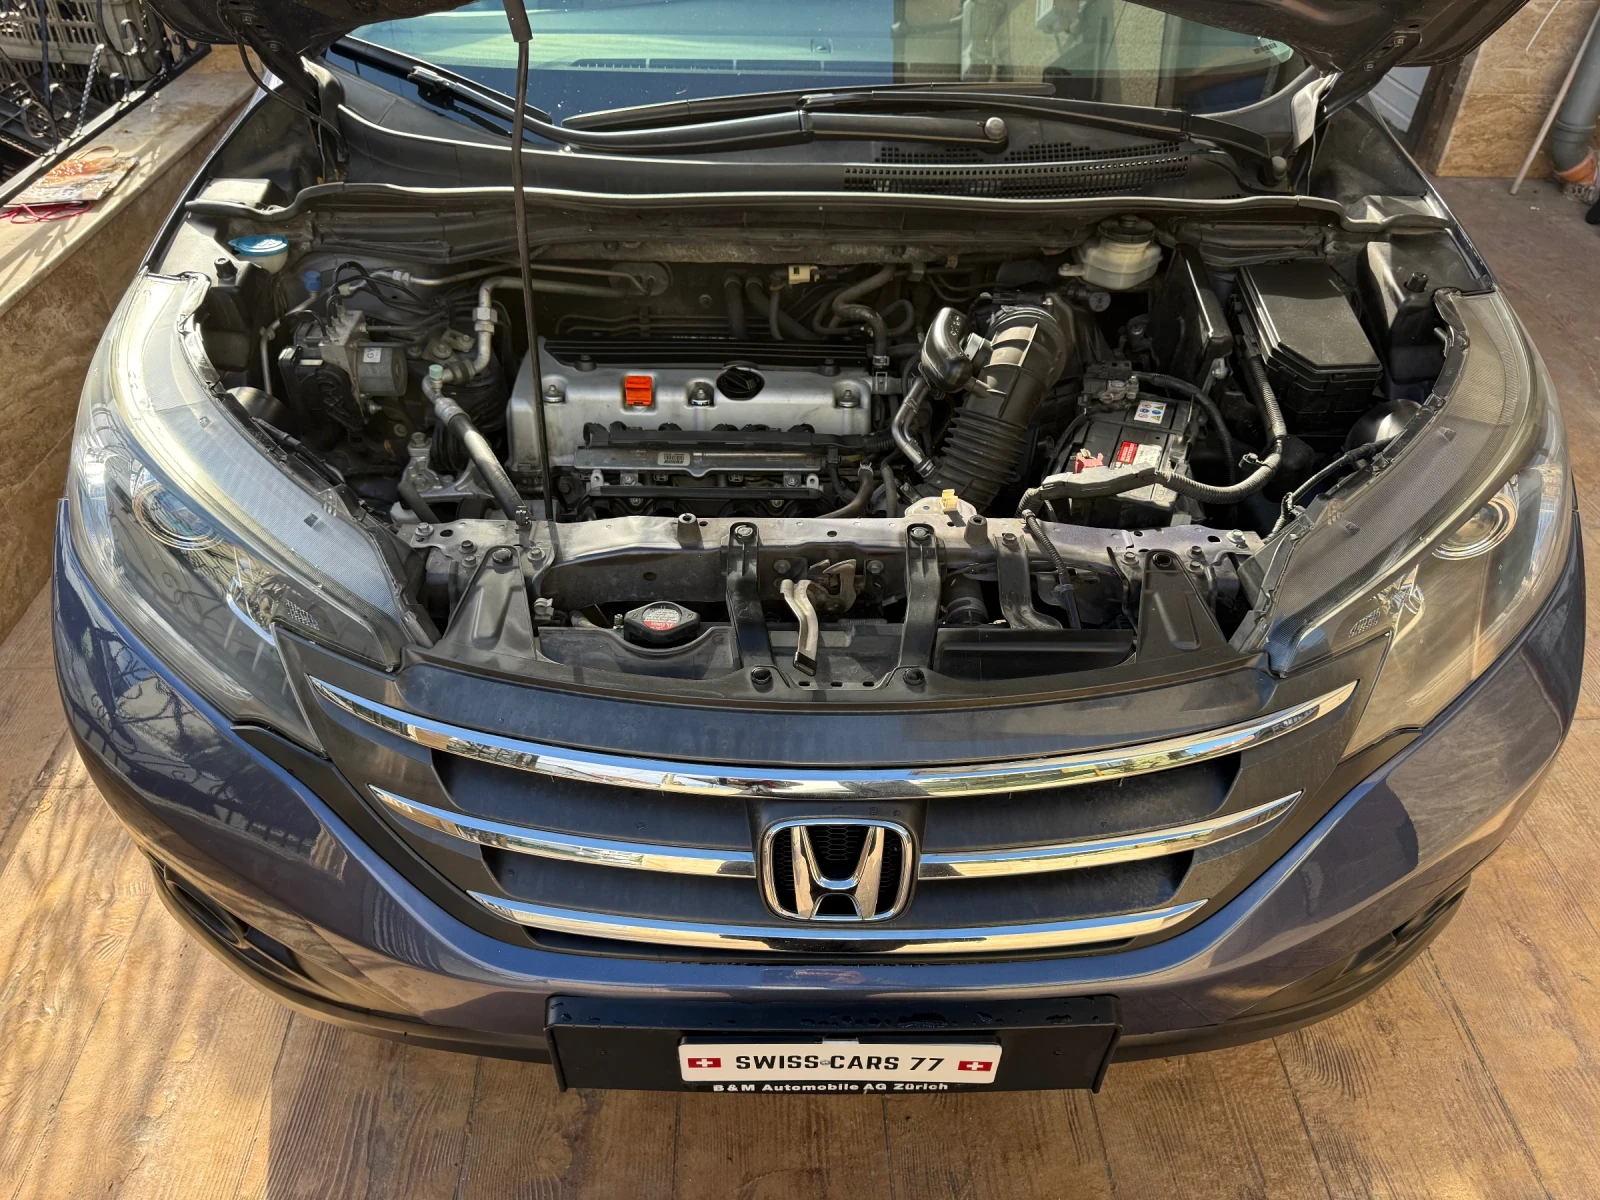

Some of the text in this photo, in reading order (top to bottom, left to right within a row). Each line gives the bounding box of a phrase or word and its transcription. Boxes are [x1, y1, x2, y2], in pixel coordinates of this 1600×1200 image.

[735, 1055, 945, 1071] SWISS CARS 77
[762, 1083, 859, 1092] Automobile
[863, 1083, 887, 1092] AG
[893, 1082, 949, 1091] Zürich
